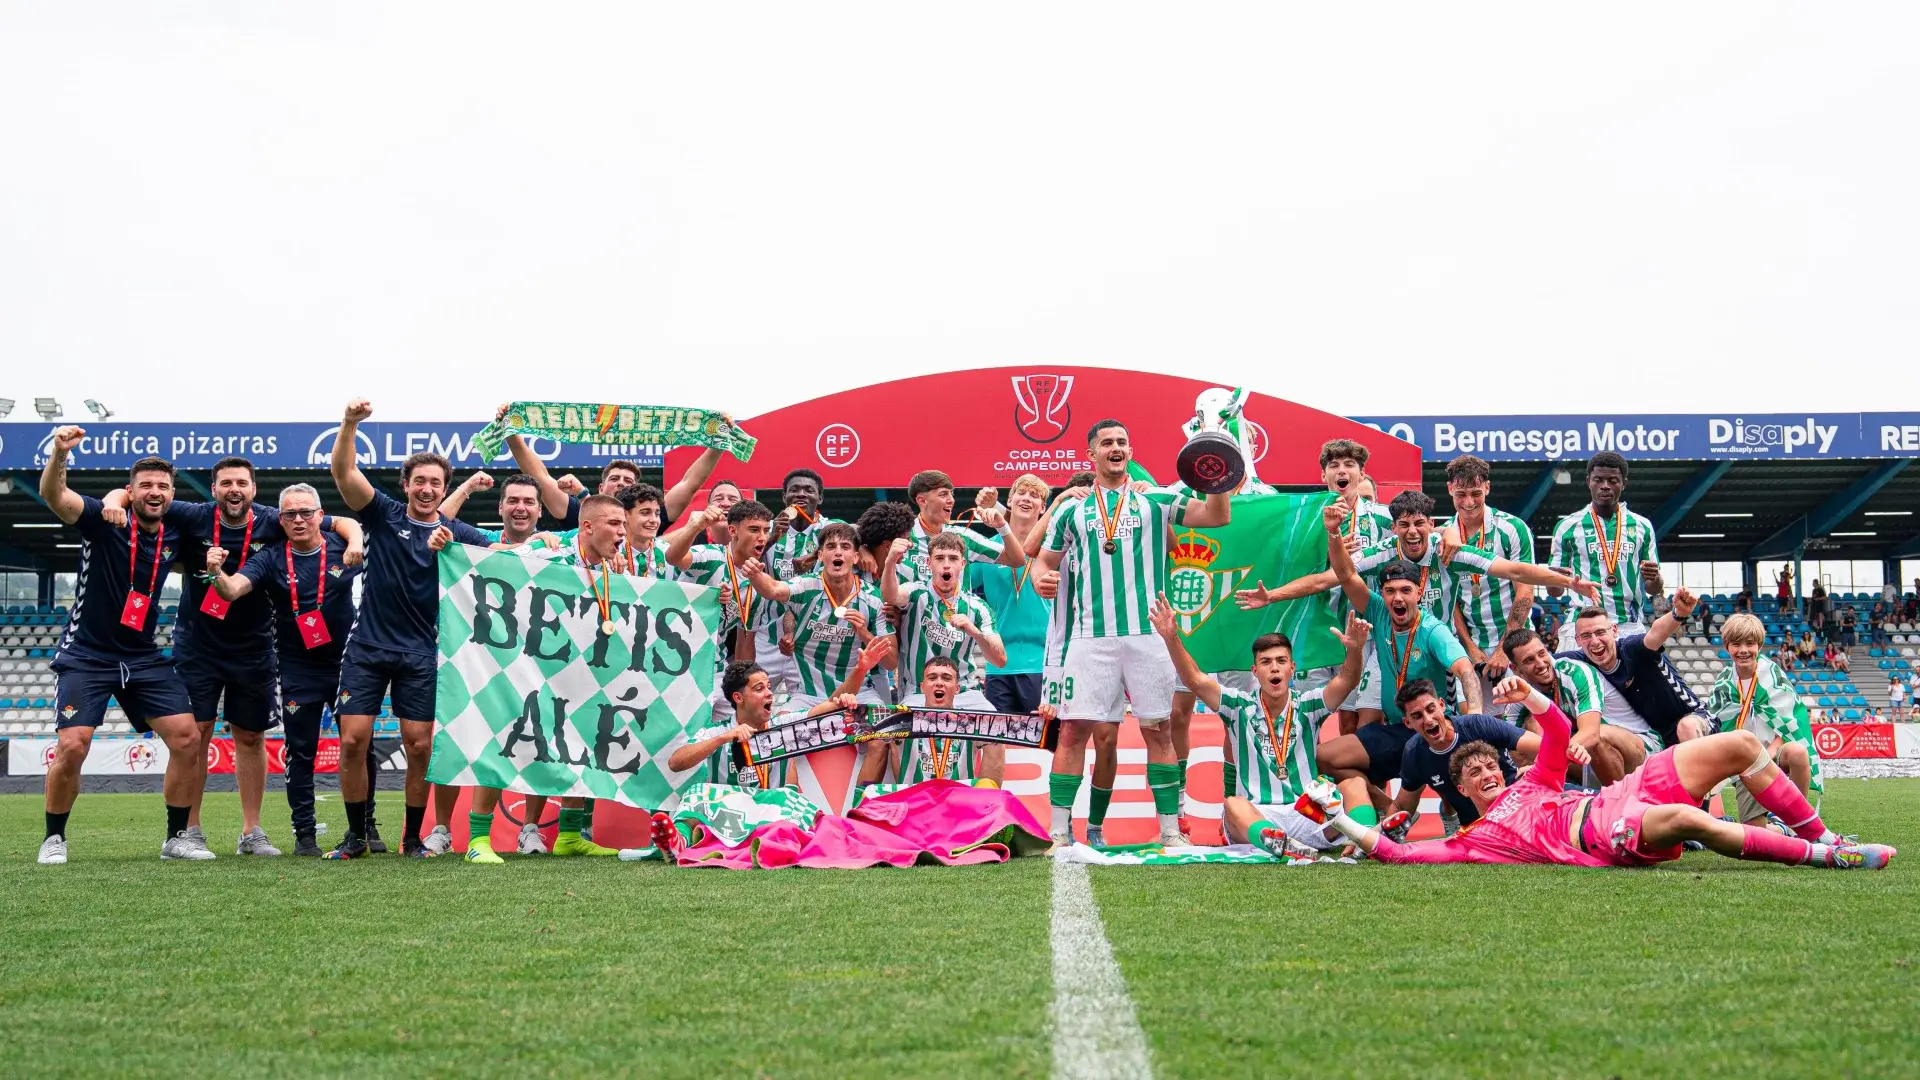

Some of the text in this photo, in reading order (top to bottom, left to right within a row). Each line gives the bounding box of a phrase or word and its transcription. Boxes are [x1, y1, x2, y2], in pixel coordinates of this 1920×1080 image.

[525, 406, 703, 432] REAL BETIS
[171, 431, 278, 460] pizarras
[1434, 423, 1581, 458] Bernesga
[1587, 422, 1680, 452] Motor
[1708, 418, 1838, 454] Disaply
[313, 452, 371, 464] MN
[1009, 449, 1076, 460] COPA DE
[1710, 446, 1769, 454] www.disaply.com
[993, 461, 1092, 471] CAMPEONES
[469, 573, 693, 676] BETIS
[925, 629, 955, 648] GREEN
[498, 686, 649, 776] ALÉ
[755, 714, 848, 759] PINO
